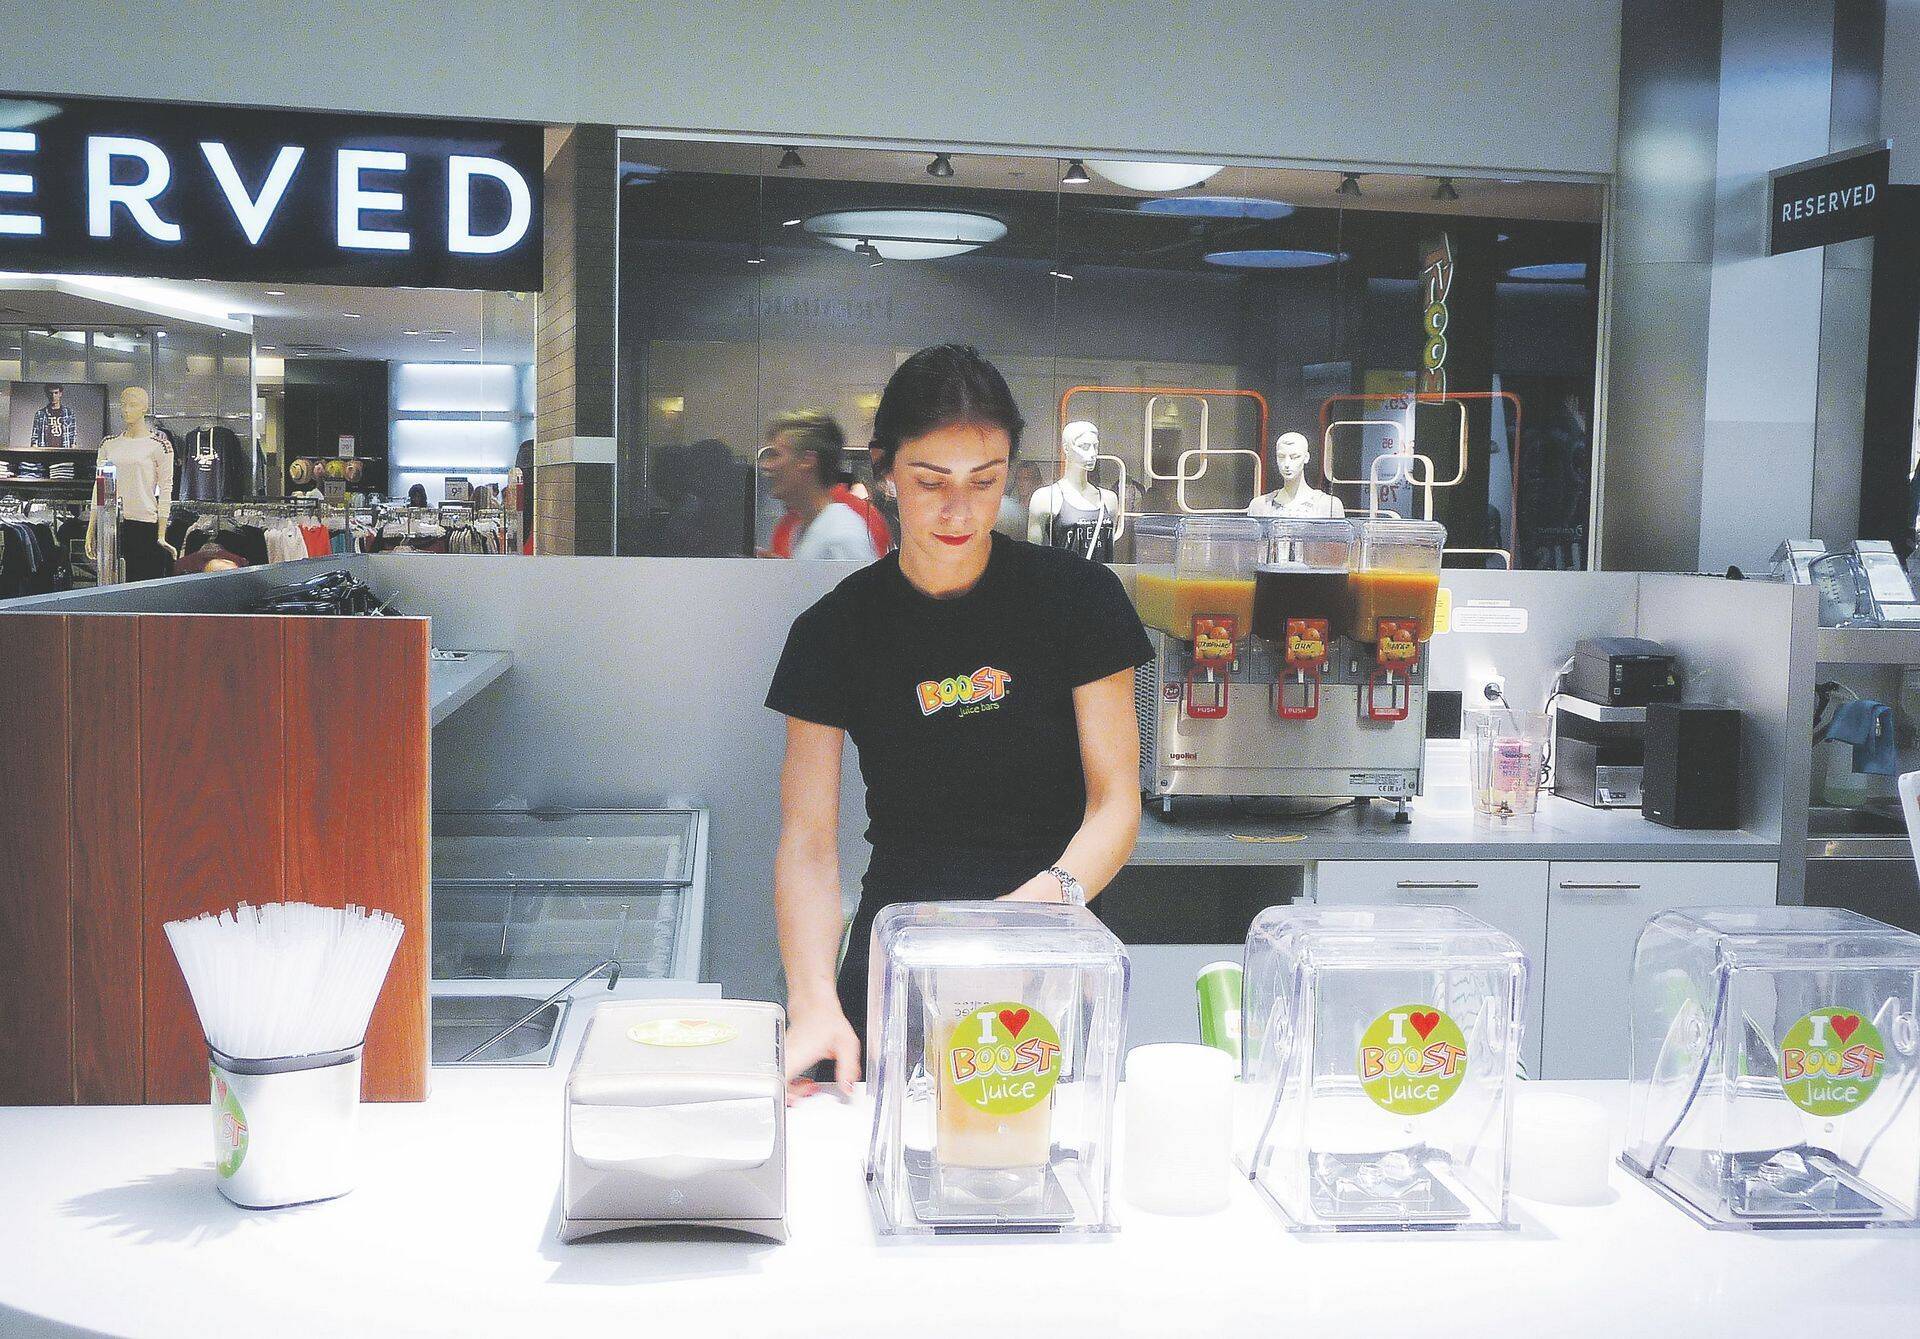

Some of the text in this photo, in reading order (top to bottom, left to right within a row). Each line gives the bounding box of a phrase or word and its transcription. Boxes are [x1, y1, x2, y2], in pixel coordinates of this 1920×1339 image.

[1782, 183, 1876, 222] RESERVED
[917, 666, 1011, 716] BOOST
[982, 702, 1000, 712] bars
[1170, 752, 1198, 761] ugolini
[976, 1011, 998, 1044] I
[1387, 1013, 1409, 1045] I
[1808, 1016, 1830, 1047] I
[950, 1038, 1062, 1084] BOOST
[1361, 1042, 1467, 1083] BOOST
[1782, 1043, 1885, 1084] BOOST
